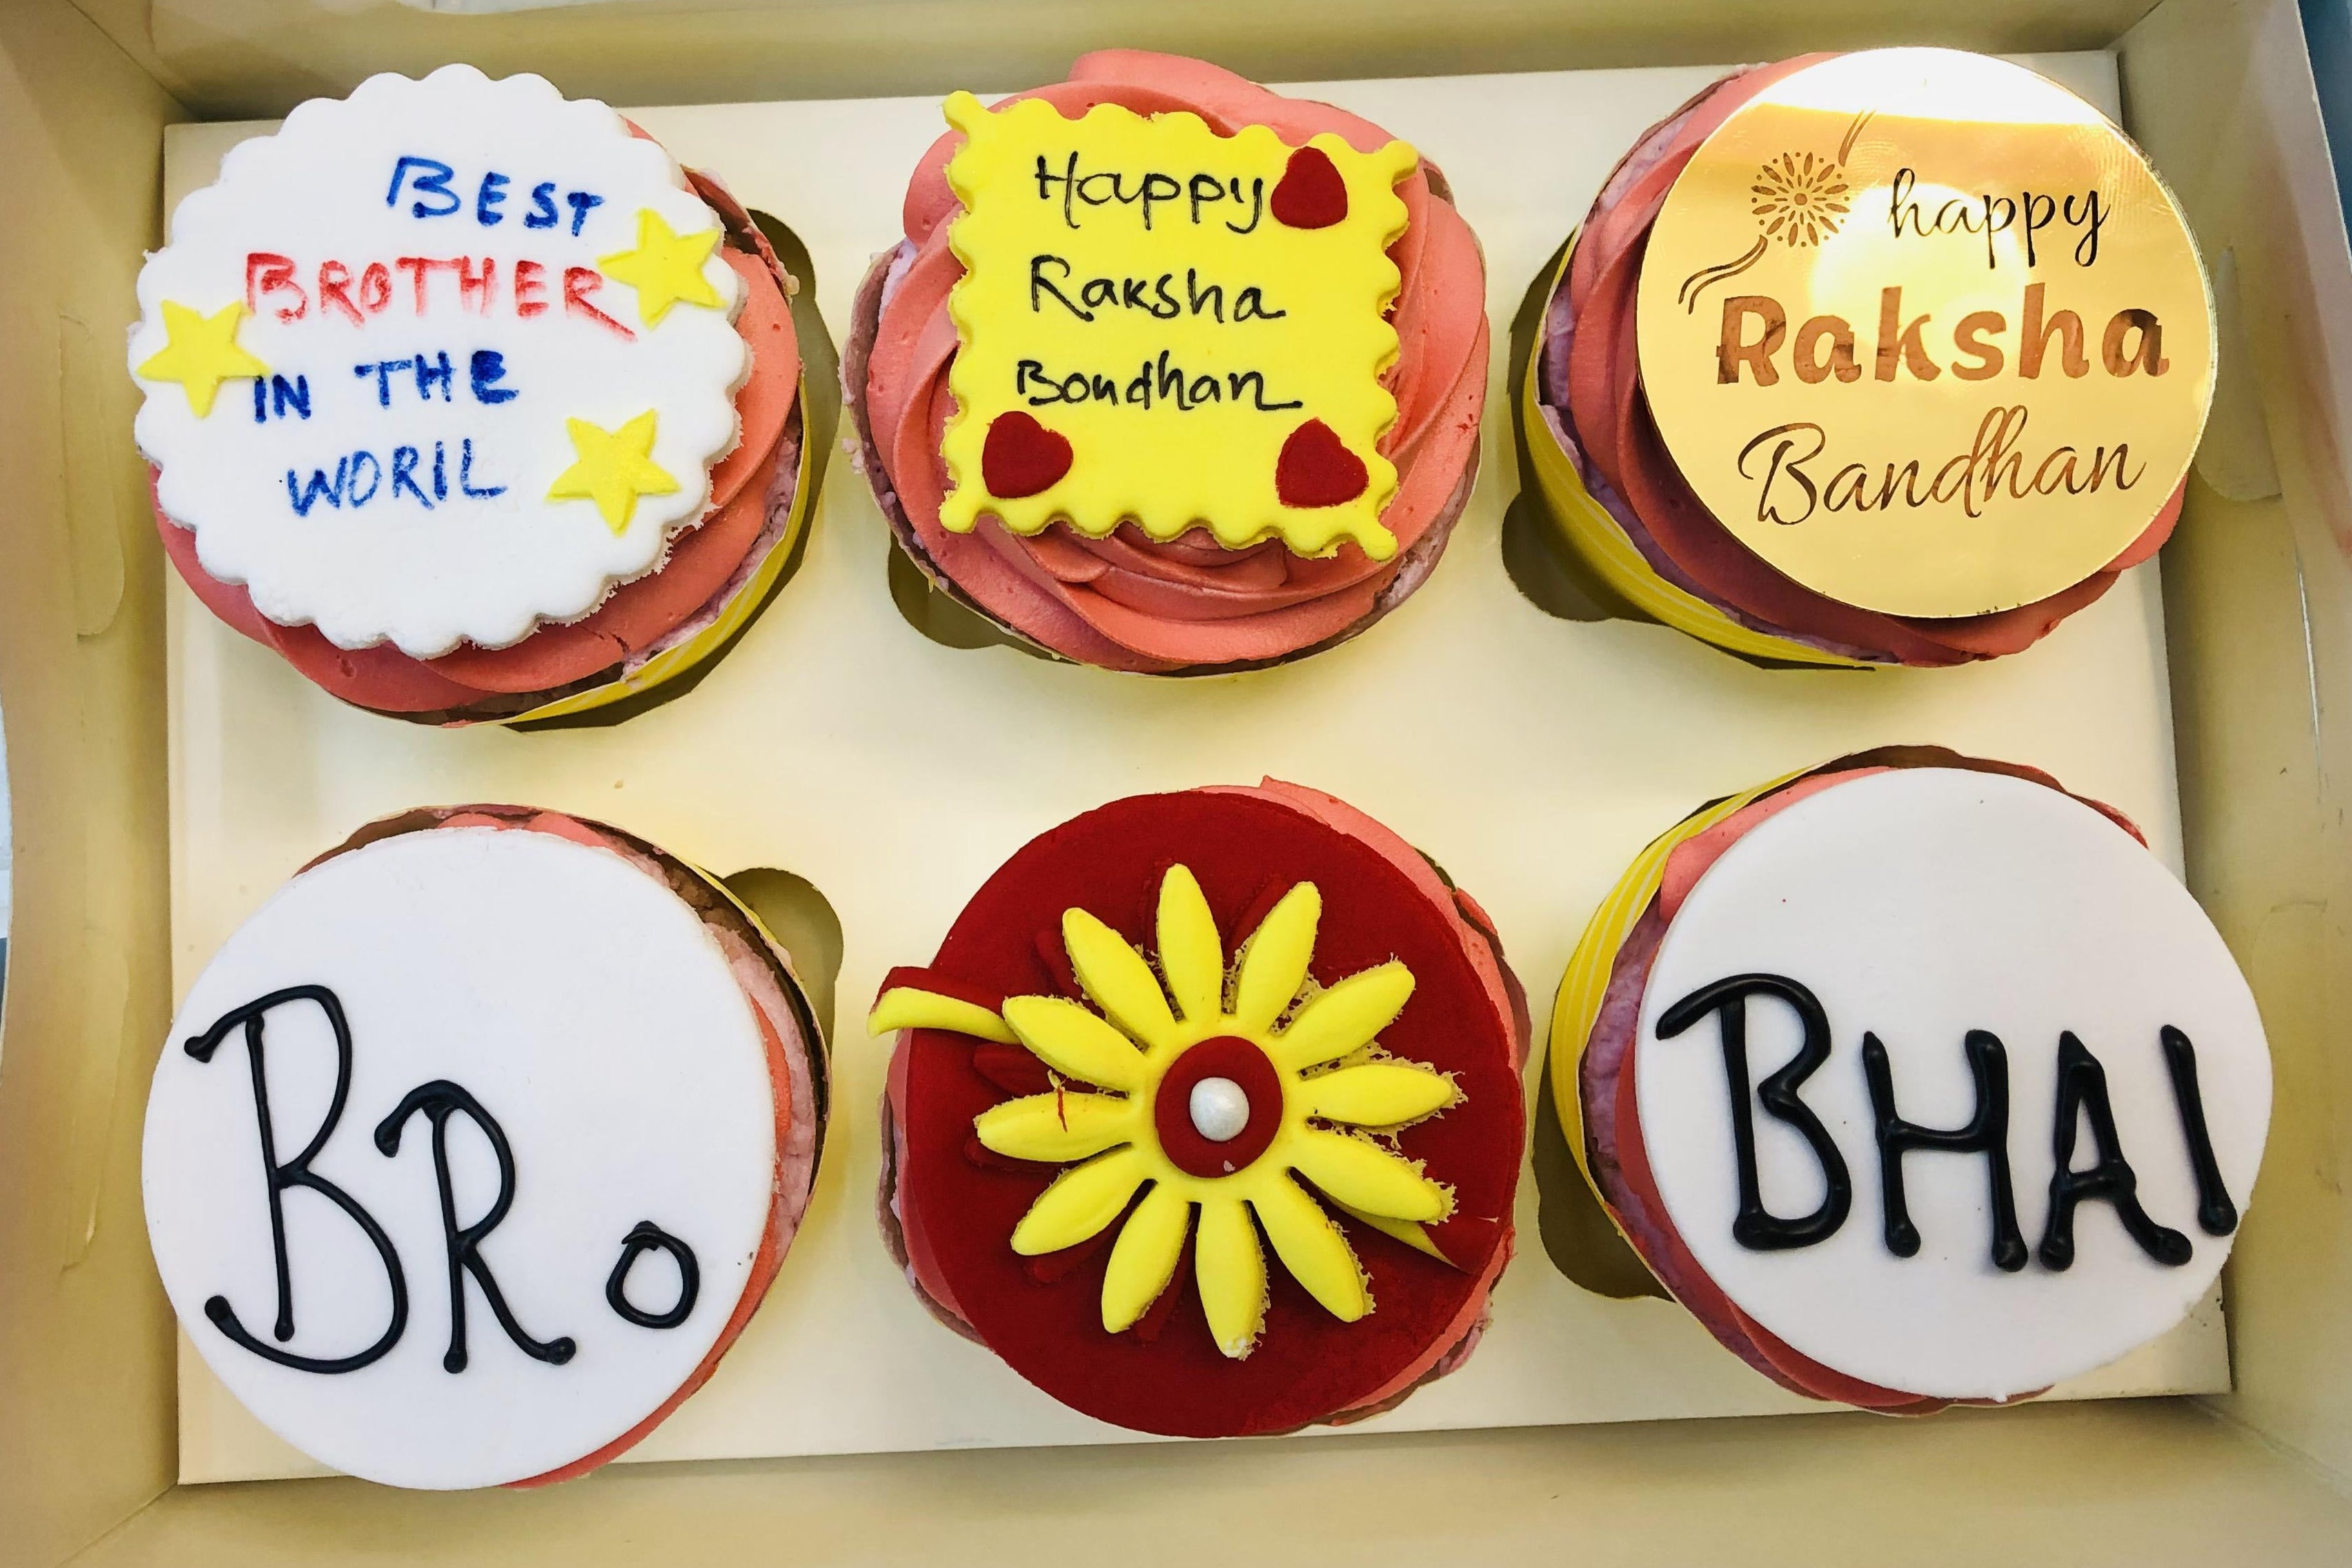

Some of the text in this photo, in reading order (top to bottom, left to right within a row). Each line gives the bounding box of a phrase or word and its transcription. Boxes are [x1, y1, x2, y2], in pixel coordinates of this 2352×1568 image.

[386, 155, 604, 237] BEST
[1035, 150, 1265, 234] Happy
[1887, 168, 2111, 269] happy
[244, 251, 638, 343] BROTHER
[1030, 255, 1287, 323] Raksha
[1715, 281, 2171, 386] Raksha
[254, 348, 520, 423] IN THE
[1737, 404, 2147, 526] Bandhan
[1656, 973, 2237, 1273] BHAI
